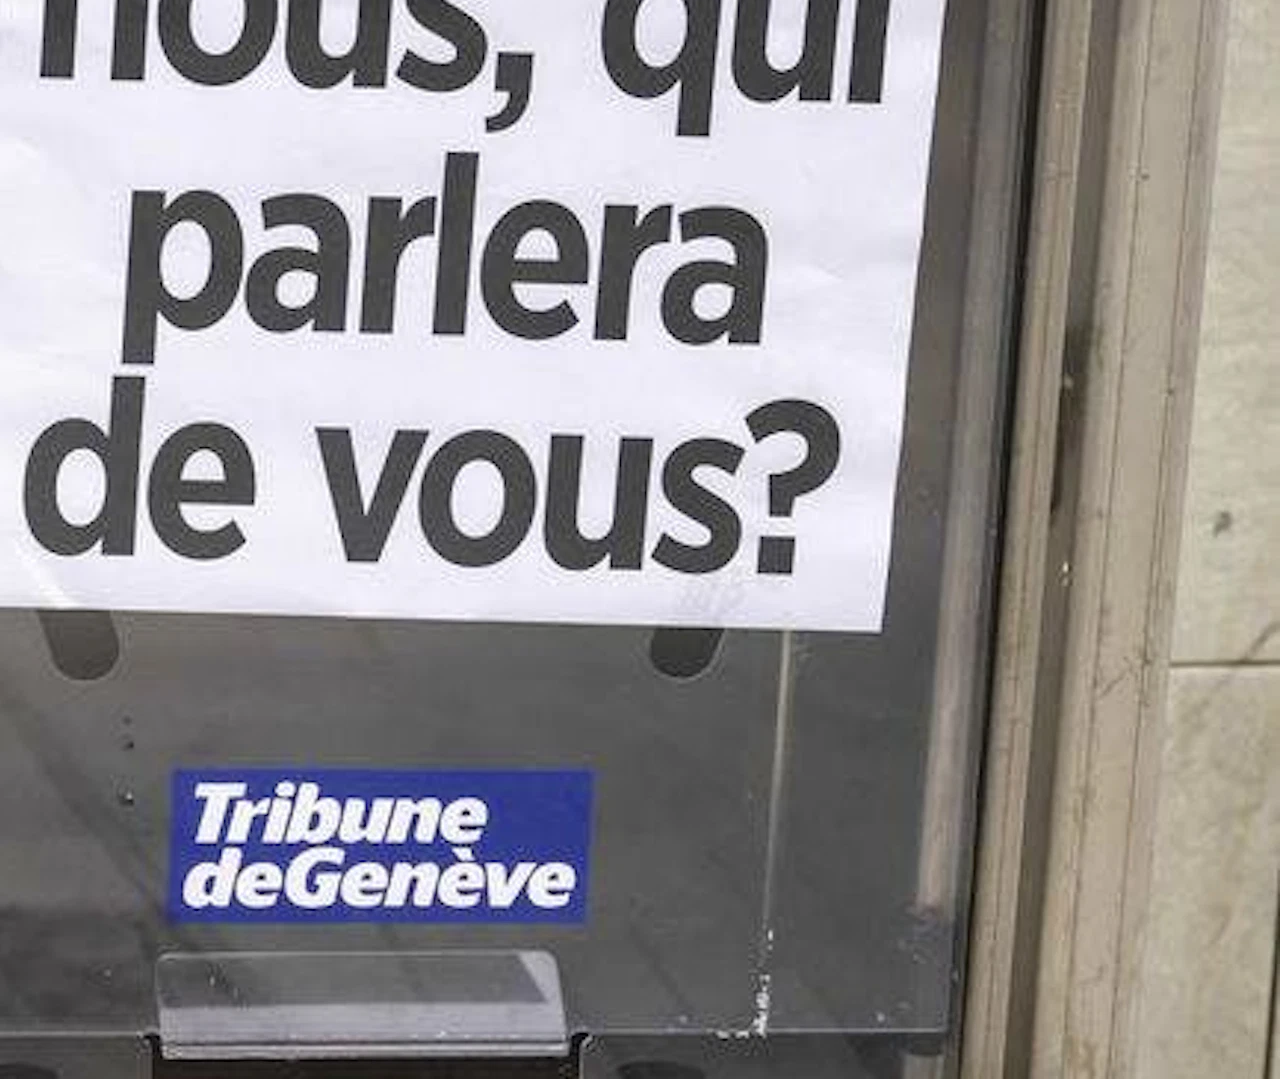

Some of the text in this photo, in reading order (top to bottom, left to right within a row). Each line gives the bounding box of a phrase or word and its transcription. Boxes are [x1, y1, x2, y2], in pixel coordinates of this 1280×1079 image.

[123, 152, 767, 364] parlera
[25, 377, 839, 575] de vous?
[183, 846, 576, 908] deGenève
[195, 782, 486, 844] Tribune
